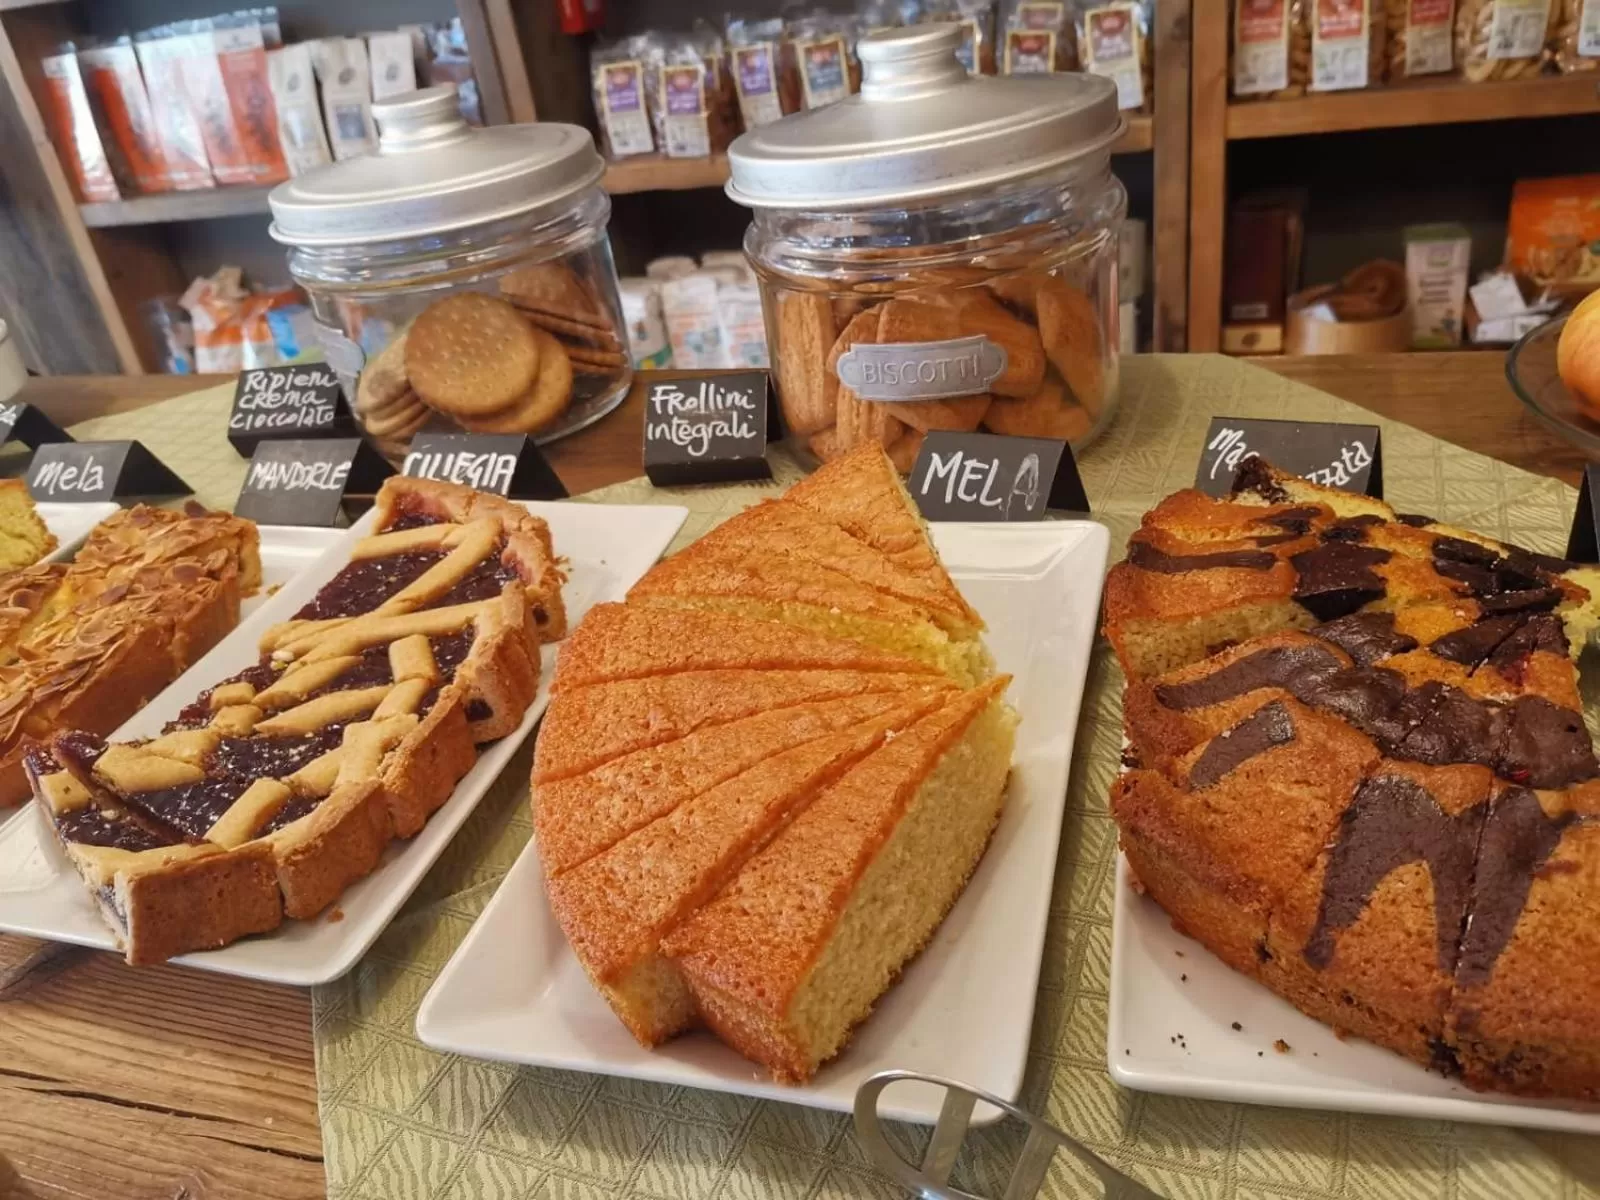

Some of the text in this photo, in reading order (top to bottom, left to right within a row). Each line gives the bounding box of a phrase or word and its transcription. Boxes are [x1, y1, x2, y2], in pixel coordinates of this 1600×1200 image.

[244, 367, 338, 397] Ripieni
[861, 353, 979, 385] BISCOTTI
[647, 410, 757, 457] integrali
[32, 455, 105, 495] Mela
[247, 461, 352, 491] MANDORLE
[920, 450, 1040, 513] MELA
